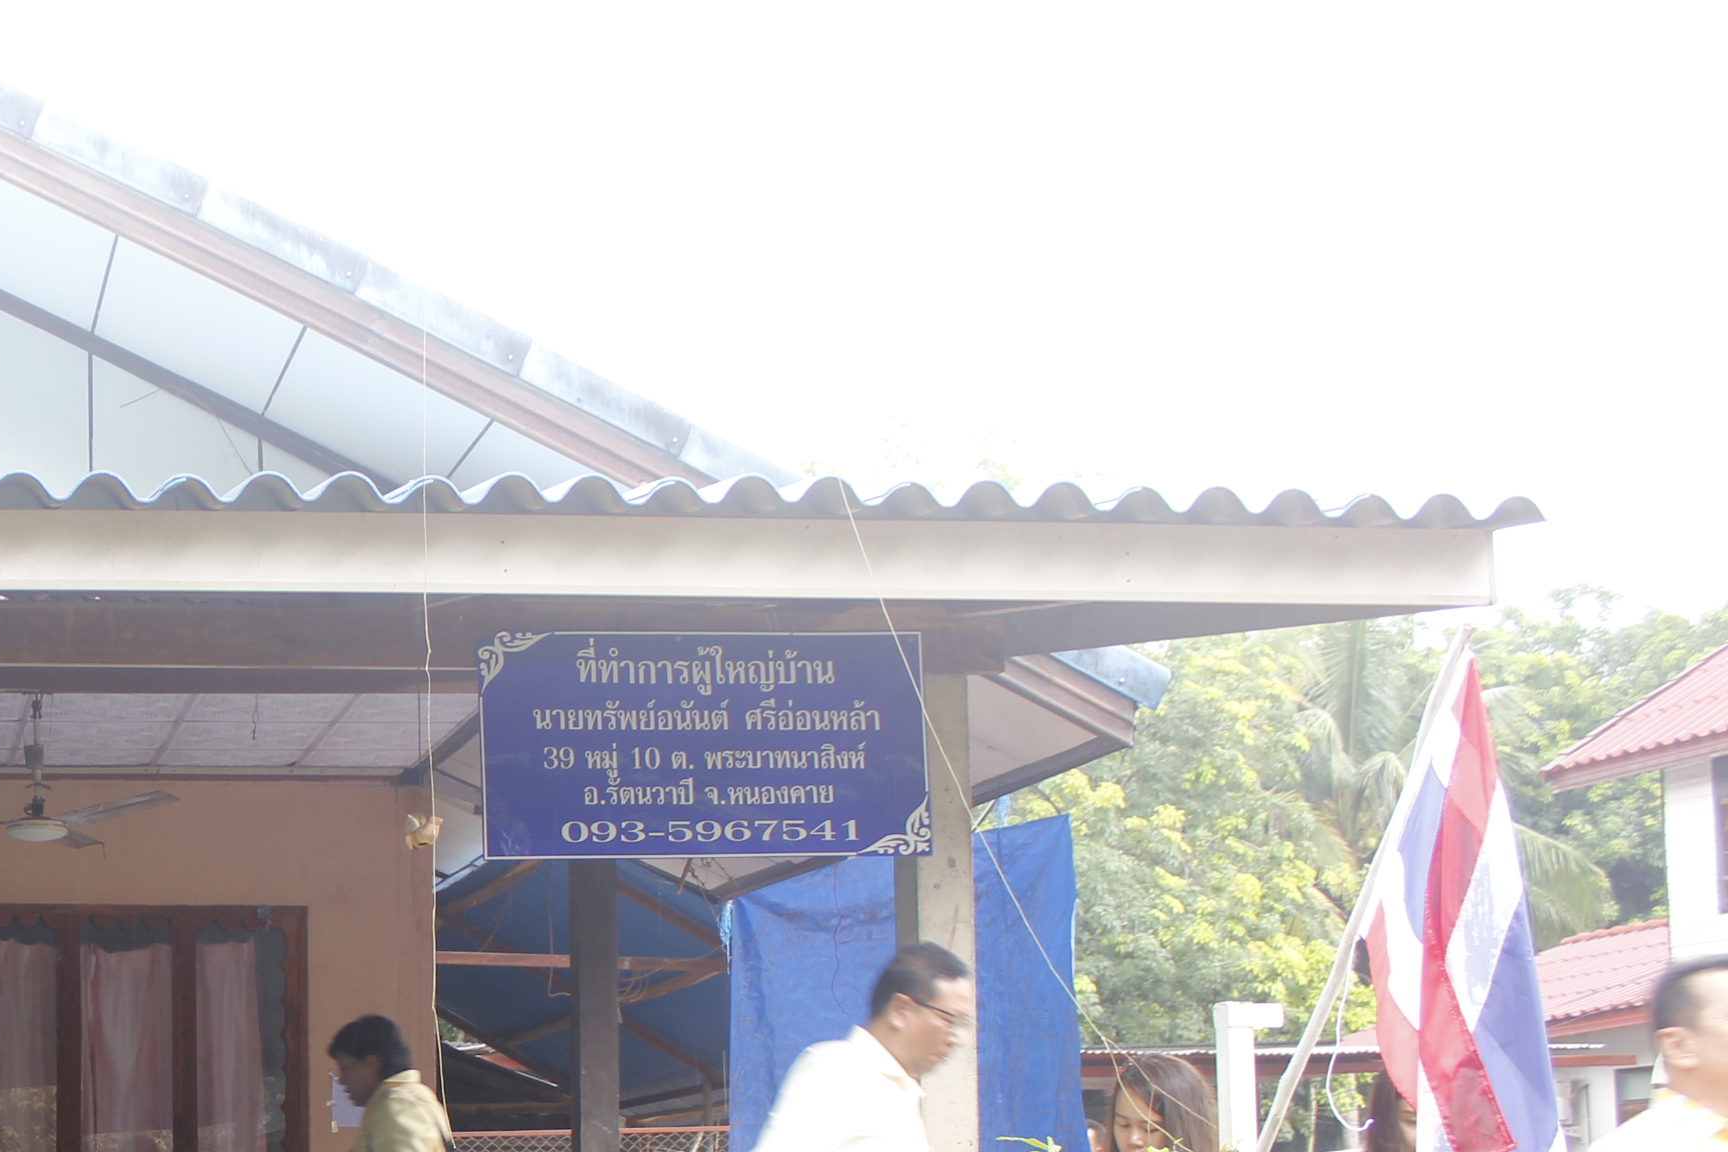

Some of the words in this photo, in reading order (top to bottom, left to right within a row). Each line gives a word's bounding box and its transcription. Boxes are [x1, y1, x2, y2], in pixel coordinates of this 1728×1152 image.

[576, 637, 836, 696] ที่ทำการผู้ใหญ่บ้าน
[533, 699, 729, 731] นายทรัพย์อนันต์
[745, 698, 881, 731] ศรีอ่อนหล้า
[543, 746, 575, 770] 39
[585, 743, 619, 778] หมู่
[631, 746, 661, 770] 10
[671, 751, 695, 770] ต.
[704, 742, 866, 770] พระบาทนาสิงห์
[584, 777, 694, 806] อ.รัตนวาปี
[704, 785, 834, 806] จ.หนองคาย
[561, 819, 860, 844] 093-5967541
